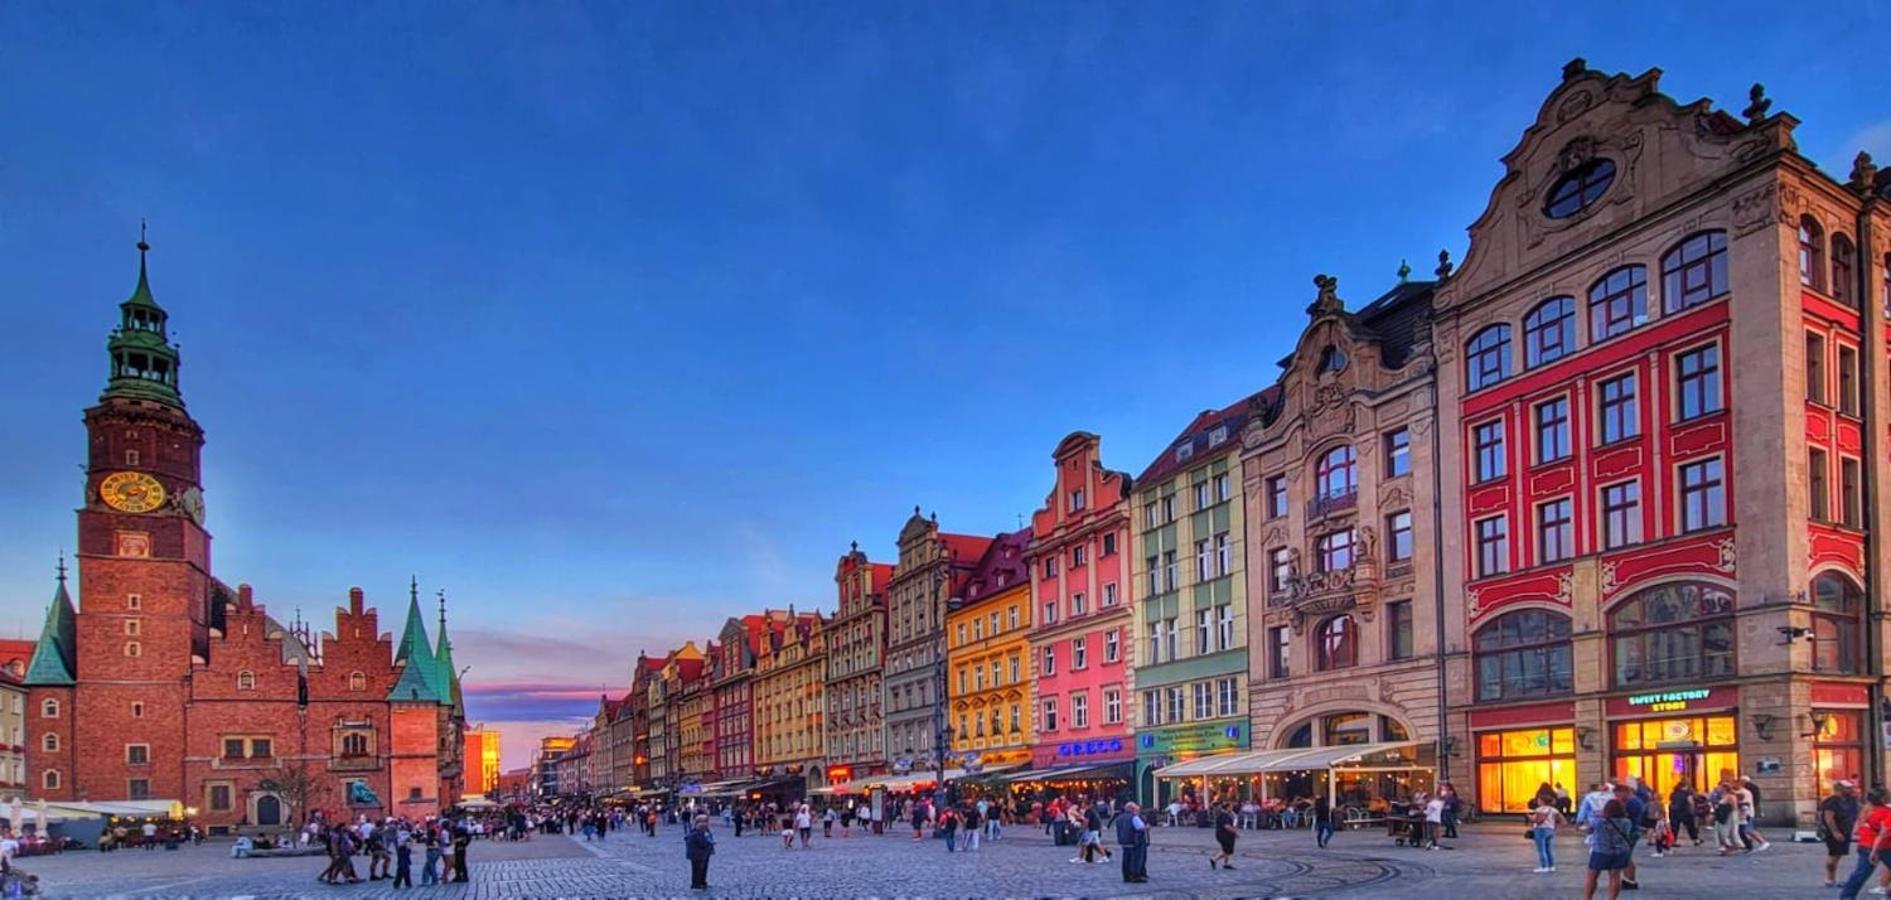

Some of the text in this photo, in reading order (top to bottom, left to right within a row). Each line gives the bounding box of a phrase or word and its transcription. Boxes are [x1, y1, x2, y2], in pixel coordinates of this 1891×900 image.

[1628, 689, 1710, 705] SWEET FACTORY
[1652, 701, 1686, 712] STORE
